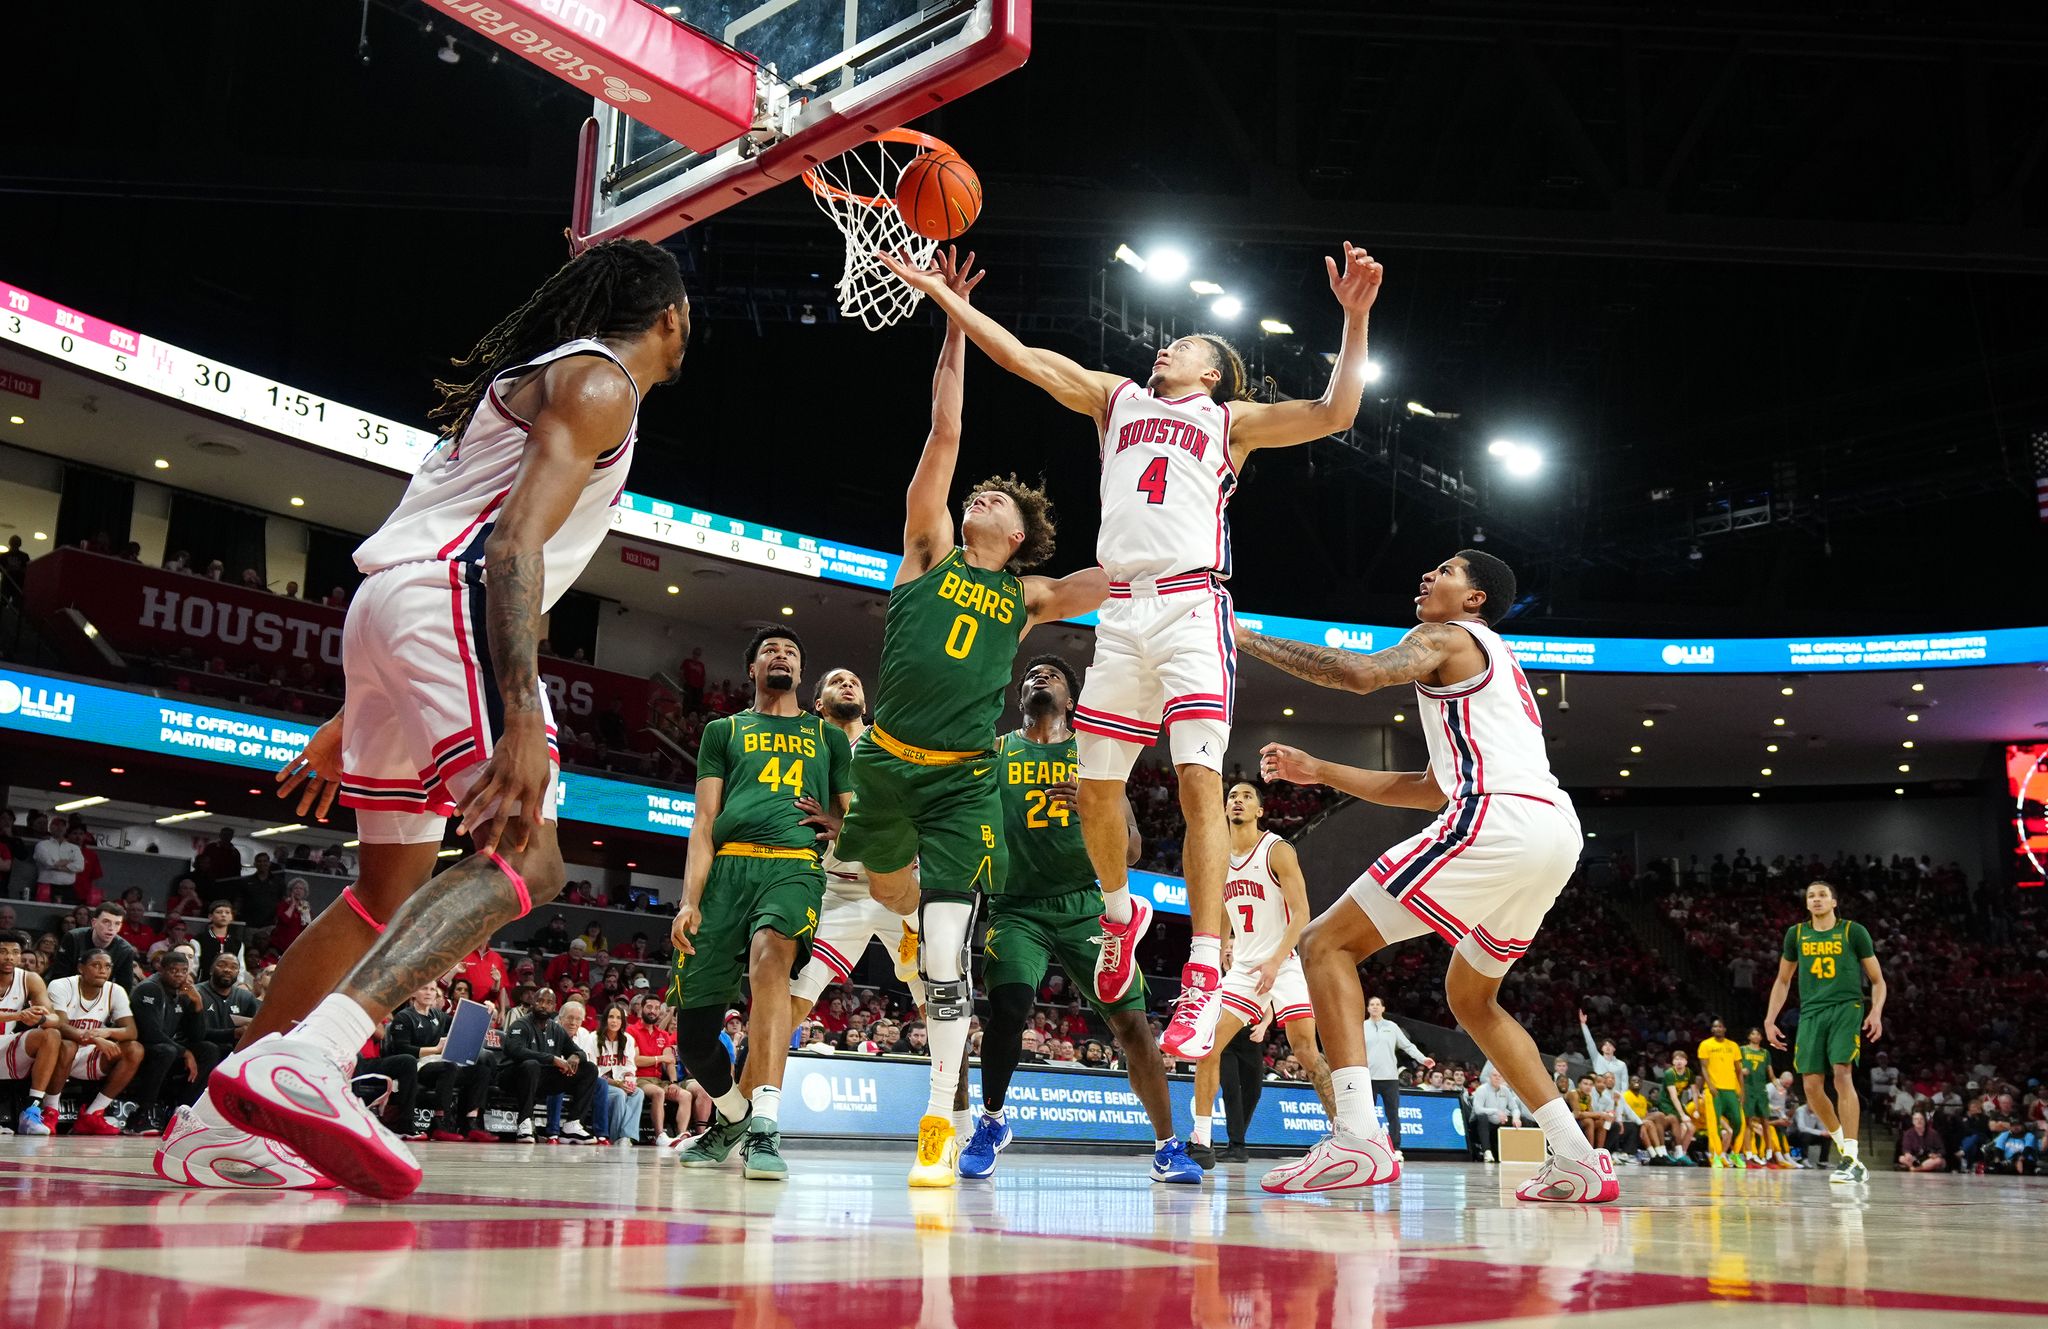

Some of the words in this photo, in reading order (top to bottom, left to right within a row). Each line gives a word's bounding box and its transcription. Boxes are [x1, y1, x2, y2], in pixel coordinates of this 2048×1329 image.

[440, 0, 604, 81] StateFar
[8, 290, 30, 312] TO
[55, 309, 86, 334] BLK
[108, 329, 136, 352] STL
[8, 316, 21, 334] 3
[61, 335, 73, 353] 0
[115, 355, 127, 372] 5
[194, 364, 231, 393] 30
[267, 386, 325, 423] 1:51
[356, 418, 389, 446] 35
[1116, 418, 1209, 462] HOUSTON
[1137, 457, 1168, 504] 4
[653, 521, 672, 535] 17
[697, 531, 705, 545] 9
[731, 539, 740, 553] 8
[767, 547, 775, 560] 0
[804, 556, 812, 569] 3
[938, 571, 1015, 624] BEARS
[138, 585, 343, 665] HOUSTO
[944, 613, 979, 659] 0
[21, 686, 75, 715] LLH
[160, 709, 193, 727] THE
[196, 716, 268, 741] OFFICIAL
[160, 728, 236, 752] PARTNER
[238, 742, 263, 757] OF
[744, 732, 816, 758] BEARS
[758, 757, 803, 797] 44
[647, 795, 670, 810] THE
[1025, 789, 1069, 828] 24
[1238, 905, 1254, 932] 7
[1802, 941, 1842, 955] BEARS
[1810, 957, 1836, 978] 43
[831, 1076, 877, 1103] LLH
[968, 1084, 981, 1098] HE
[1042, 1088, 1102, 1104] EMPLOYEE
[833, 1102, 877, 1112] HEALTHCARE
[1020, 1107, 1037, 1119] OF
[1040, 1108, 1098, 1122] HOUSTON
[1098, 1111, 1151, 1125] ATHLETIC
[1279, 1101, 1298, 1113] THE
[1300, 1102, 1326, 1115] OFFIC
[1283, 1118, 1325, 1131] PARTNER
